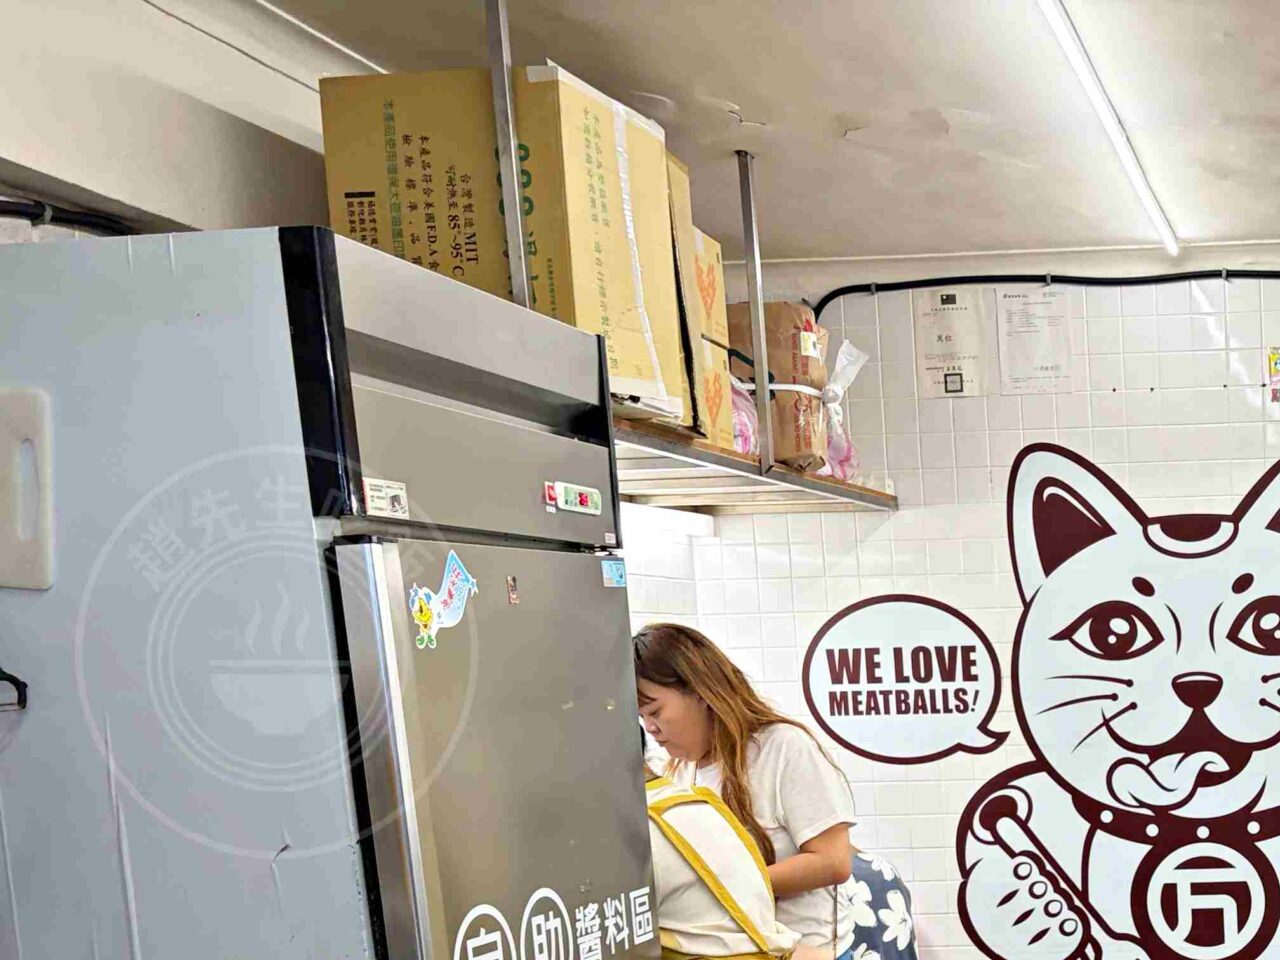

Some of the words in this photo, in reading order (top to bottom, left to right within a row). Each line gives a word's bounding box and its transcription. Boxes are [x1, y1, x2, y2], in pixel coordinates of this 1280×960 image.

[825, 647, 883, 685] WE
[893, 645, 979, 684] LOVE
[828, 687, 980, 717] MEATBALLS!
